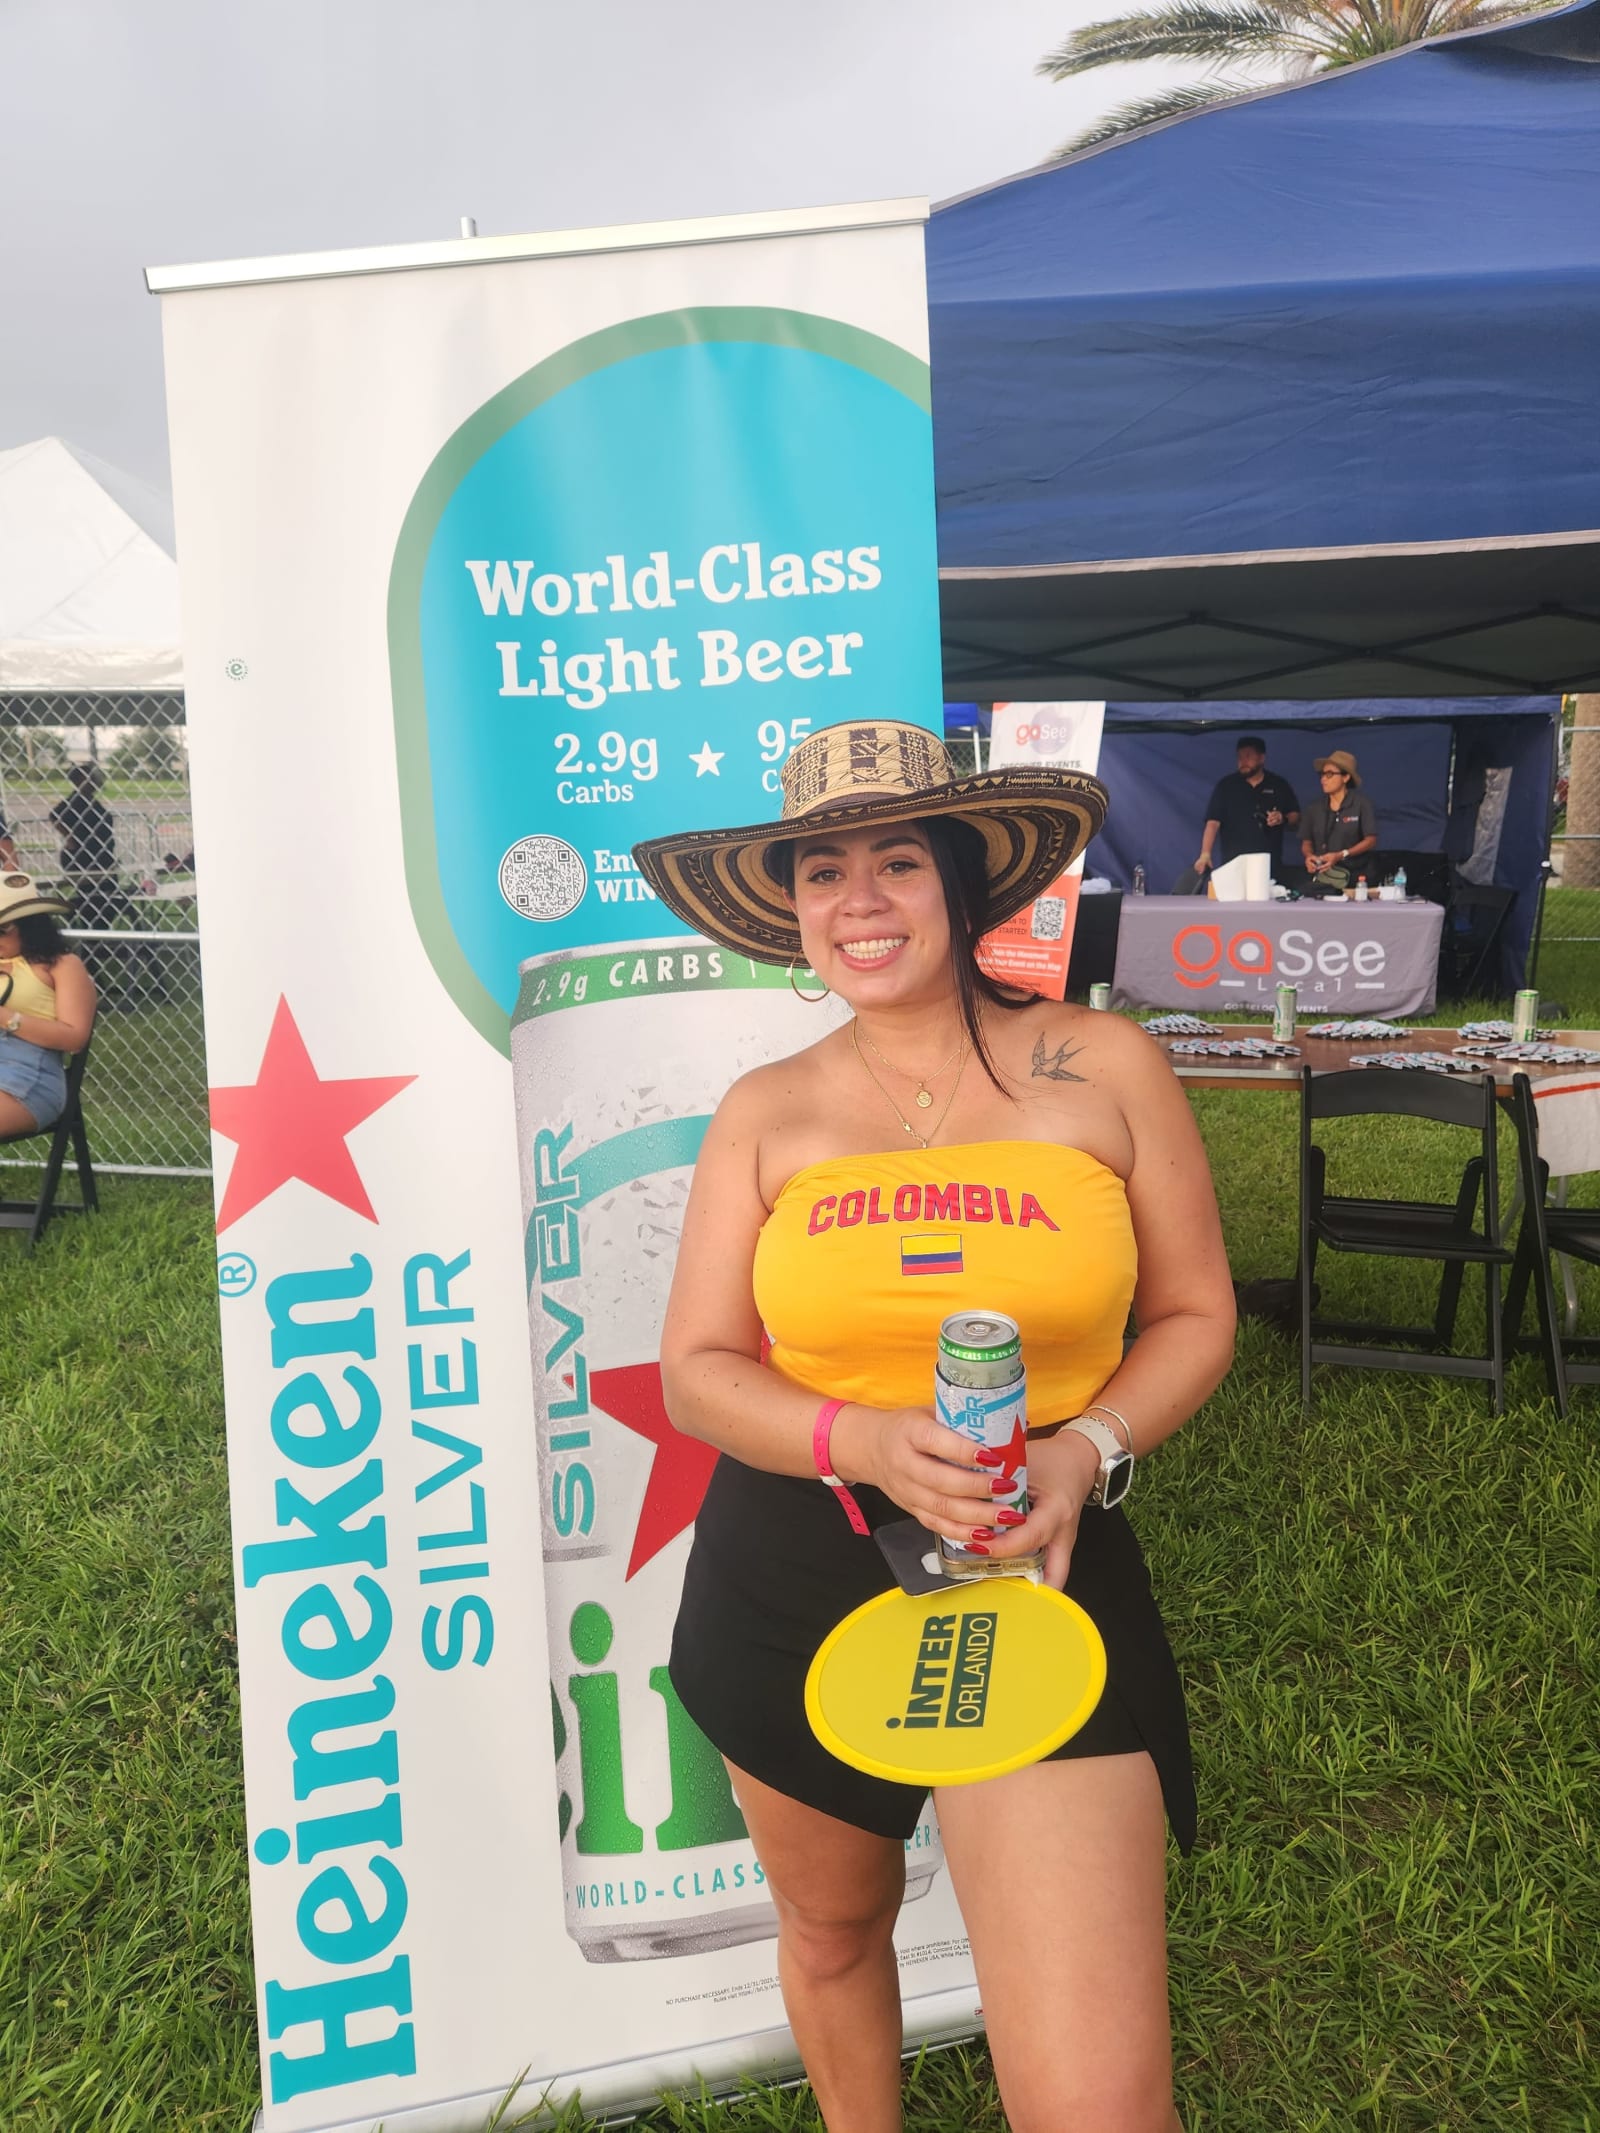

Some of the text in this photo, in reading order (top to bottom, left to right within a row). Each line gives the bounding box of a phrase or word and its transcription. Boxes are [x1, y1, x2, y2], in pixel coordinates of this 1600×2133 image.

[464, 542, 882, 616] World-Class
[496, 629, 864, 710] Light Beer
[553, 716, 812, 782] 2.9g 95
[556, 779, 635, 804] Carbs
[532, 952, 724, 1006] 2.9g CARBS
[808, 1183, 1061, 1236] COLOMBIA
[533, 1119, 596, 1538] SILVER
[403, 1248, 494, 1671] SILVER
[242, 1253, 416, 2104] Heineken
[955, 1617, 992, 1723] ORLANDO
[576, 1861, 766, 1909] WORLD-CLASS
